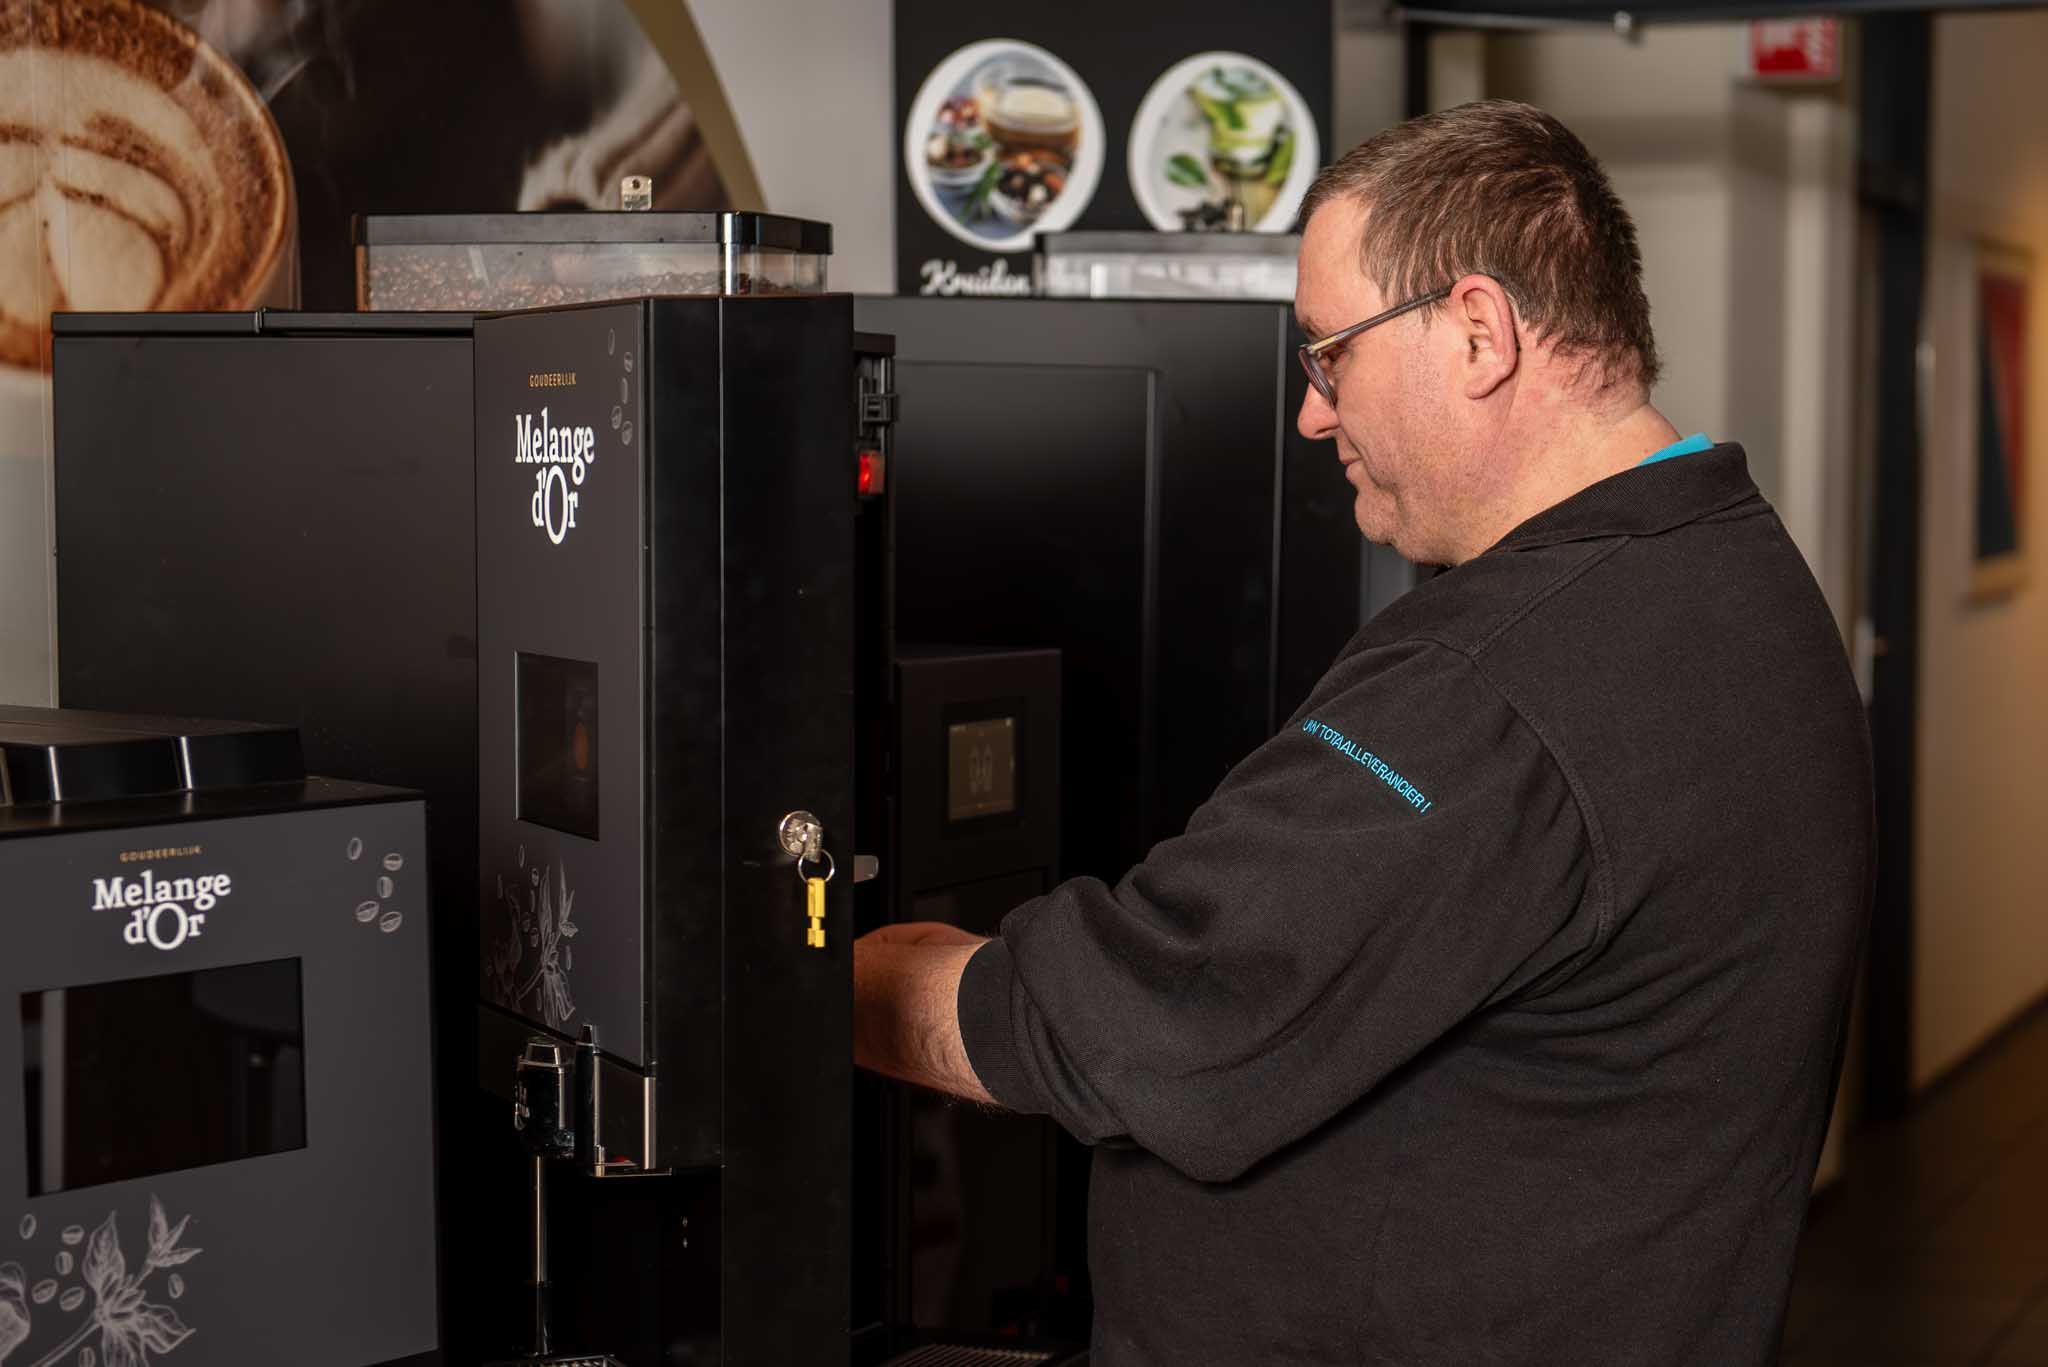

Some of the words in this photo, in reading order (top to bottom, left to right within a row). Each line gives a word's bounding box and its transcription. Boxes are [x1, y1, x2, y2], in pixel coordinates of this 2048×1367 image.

[529, 372, 577, 388] GOUDEERLIJK
[515, 406, 595, 486] Melange
[532, 465, 579, 545] d'Or
[92, 870, 232, 911] Melange
[123, 902, 205, 951] d'Or
